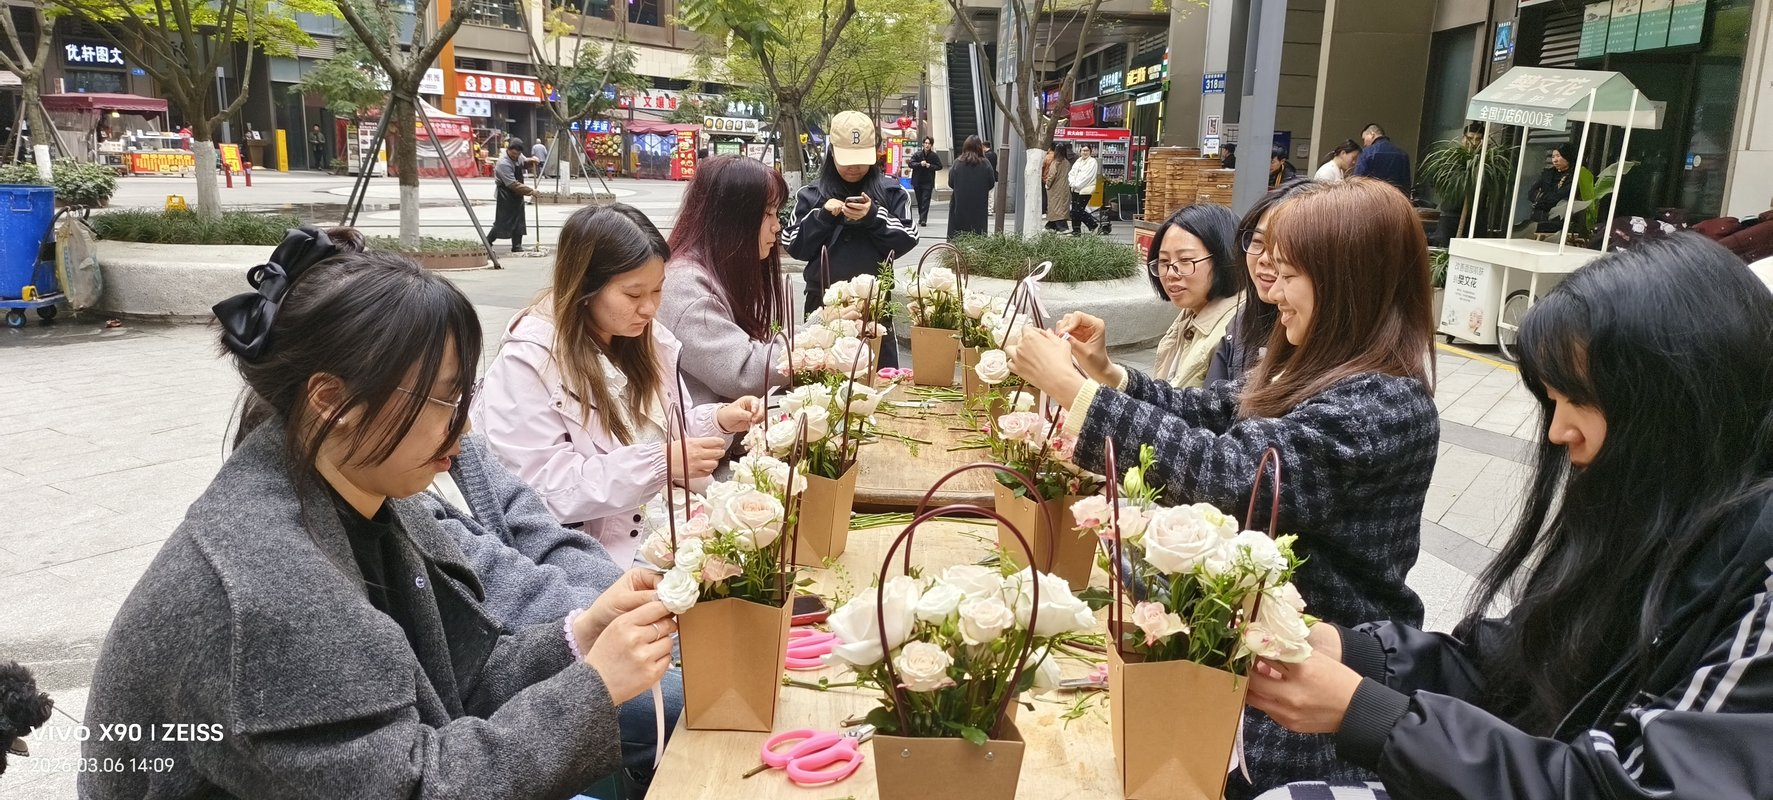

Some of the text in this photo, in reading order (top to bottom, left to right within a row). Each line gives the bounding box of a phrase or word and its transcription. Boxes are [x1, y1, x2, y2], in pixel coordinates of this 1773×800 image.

[65, 43, 124, 65] 优轩图文
[1205, 79, 1218, 90] 318
[1504, 74, 1592, 95] 樊文花
[1479, 105, 1554, 127] 全国门店6000家
[852, 131, 860, 144] B
